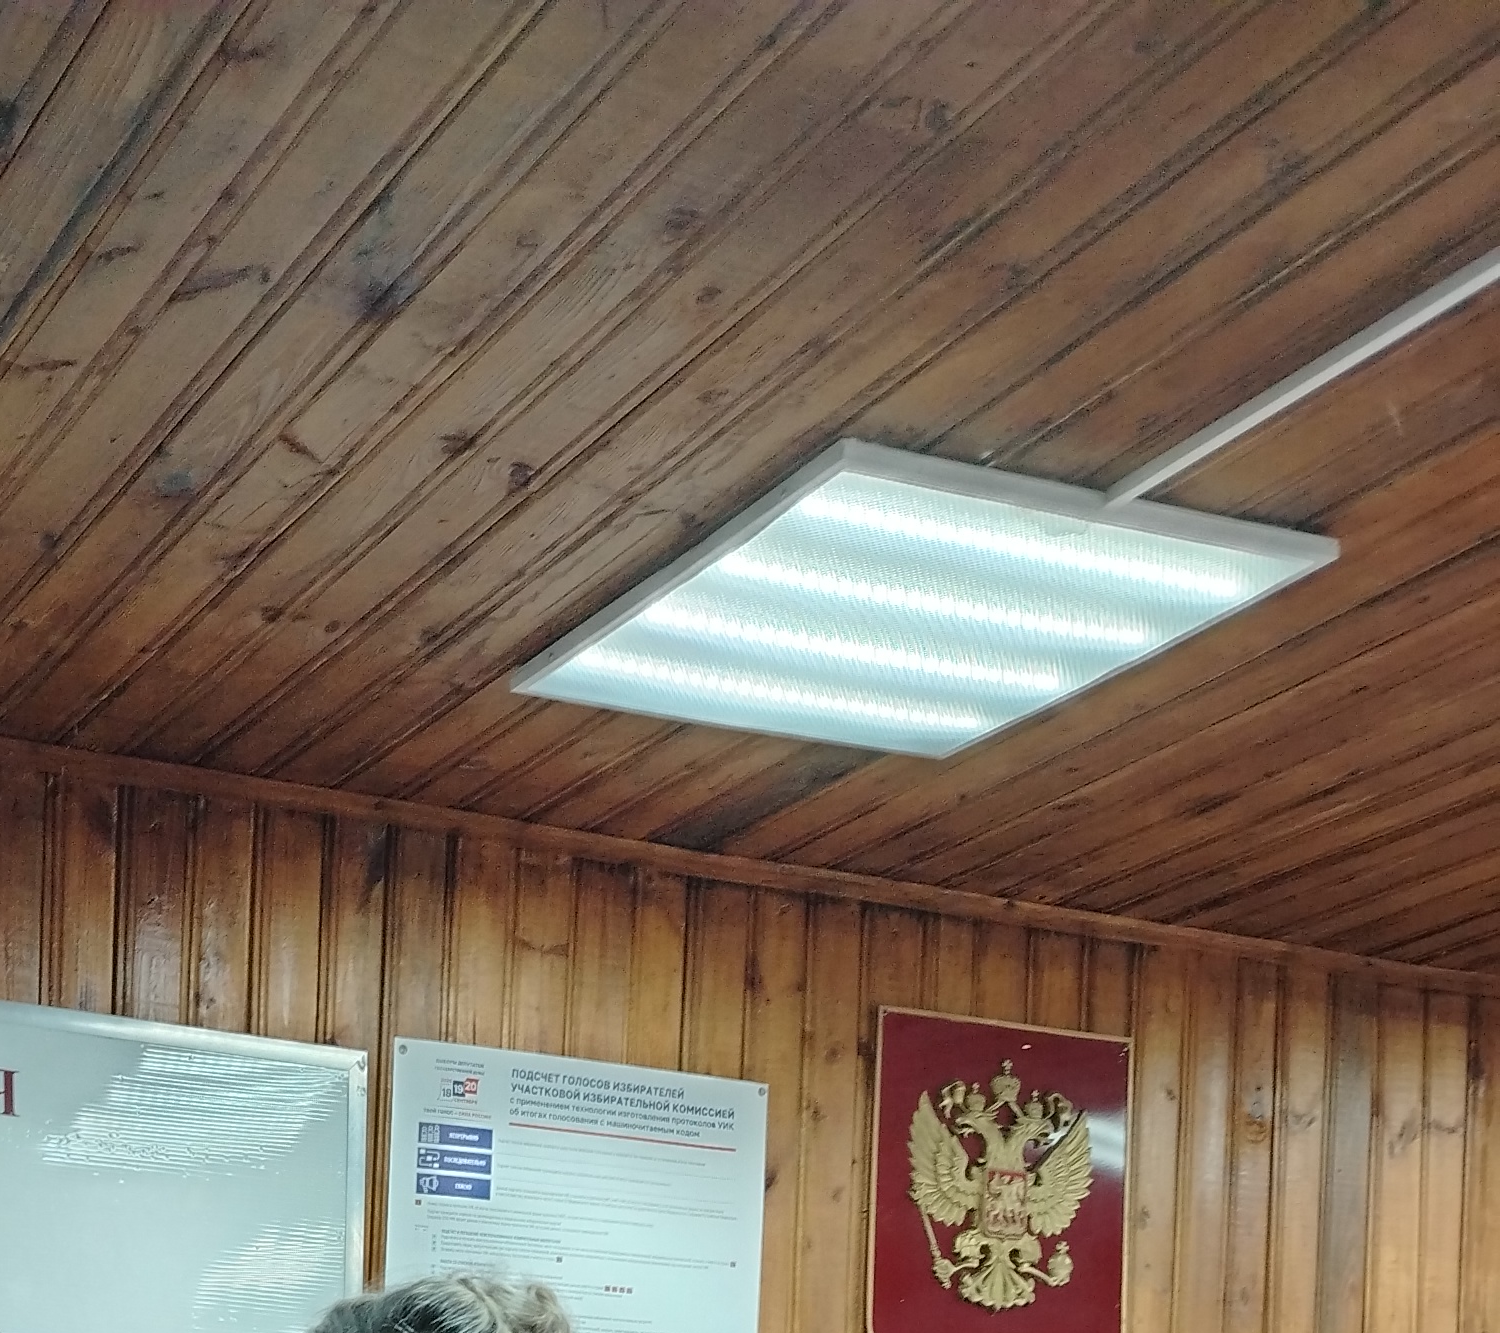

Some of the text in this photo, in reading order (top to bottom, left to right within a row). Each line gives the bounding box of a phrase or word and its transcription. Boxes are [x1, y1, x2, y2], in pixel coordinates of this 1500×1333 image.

[453, 1084, 464, 1094] 19
[464, 1081, 477, 1092] 20
[511, 1068, 685, 1100] ПОДСЧЕТ ГОЛОСОВ ИЗБИРАТЕЛЕЙ
[509, 1107, 520, 1116] об
[520, 1110, 547, 1120] итогах
[548, 1113, 599, 1126] голосования
[510, 1082, 735, 1120] УЧАСТКОВОЙ ИЗБИРАТЕЛЬНОЙ КОМИССИЕЙ
[516, 1098, 570, 1111] применением
[571, 1105, 617, 1117] технологии
[617, 1110, 670, 1124] изготовления
[671, 1116, 716, 1129] протоколов
[718, 1120, 735, 1131] УИК
